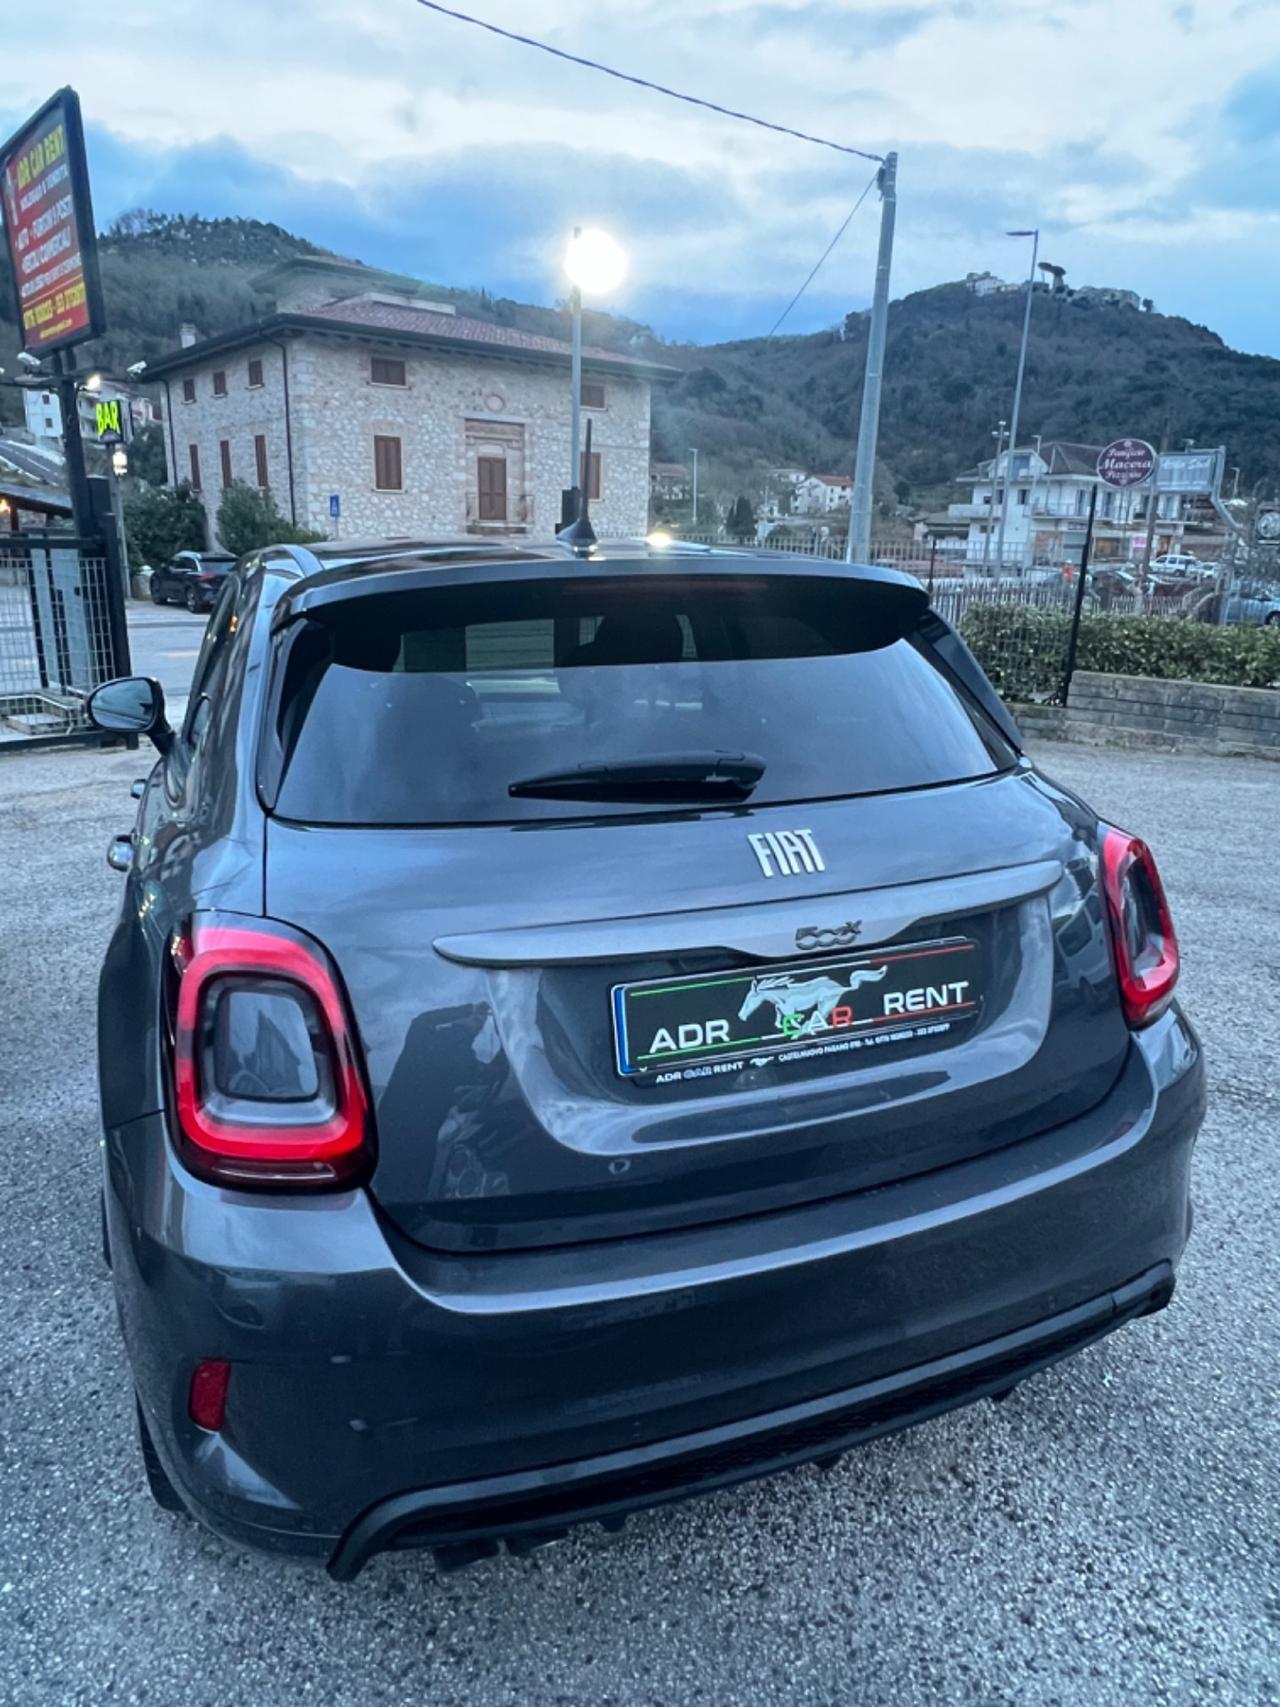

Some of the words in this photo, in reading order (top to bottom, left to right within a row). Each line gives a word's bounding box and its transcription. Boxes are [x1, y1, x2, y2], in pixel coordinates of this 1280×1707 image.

[96, 400, 121, 436] BAR
[746, 828, 826, 878] FIAT
[649, 1018, 731, 1054] ADR
[781, 1005, 853, 1039] CAR
[883, 979, 970, 1016] RENT
[656, 1071, 682, 1084] ADR
[713, 1061, 744, 1074] RENT
